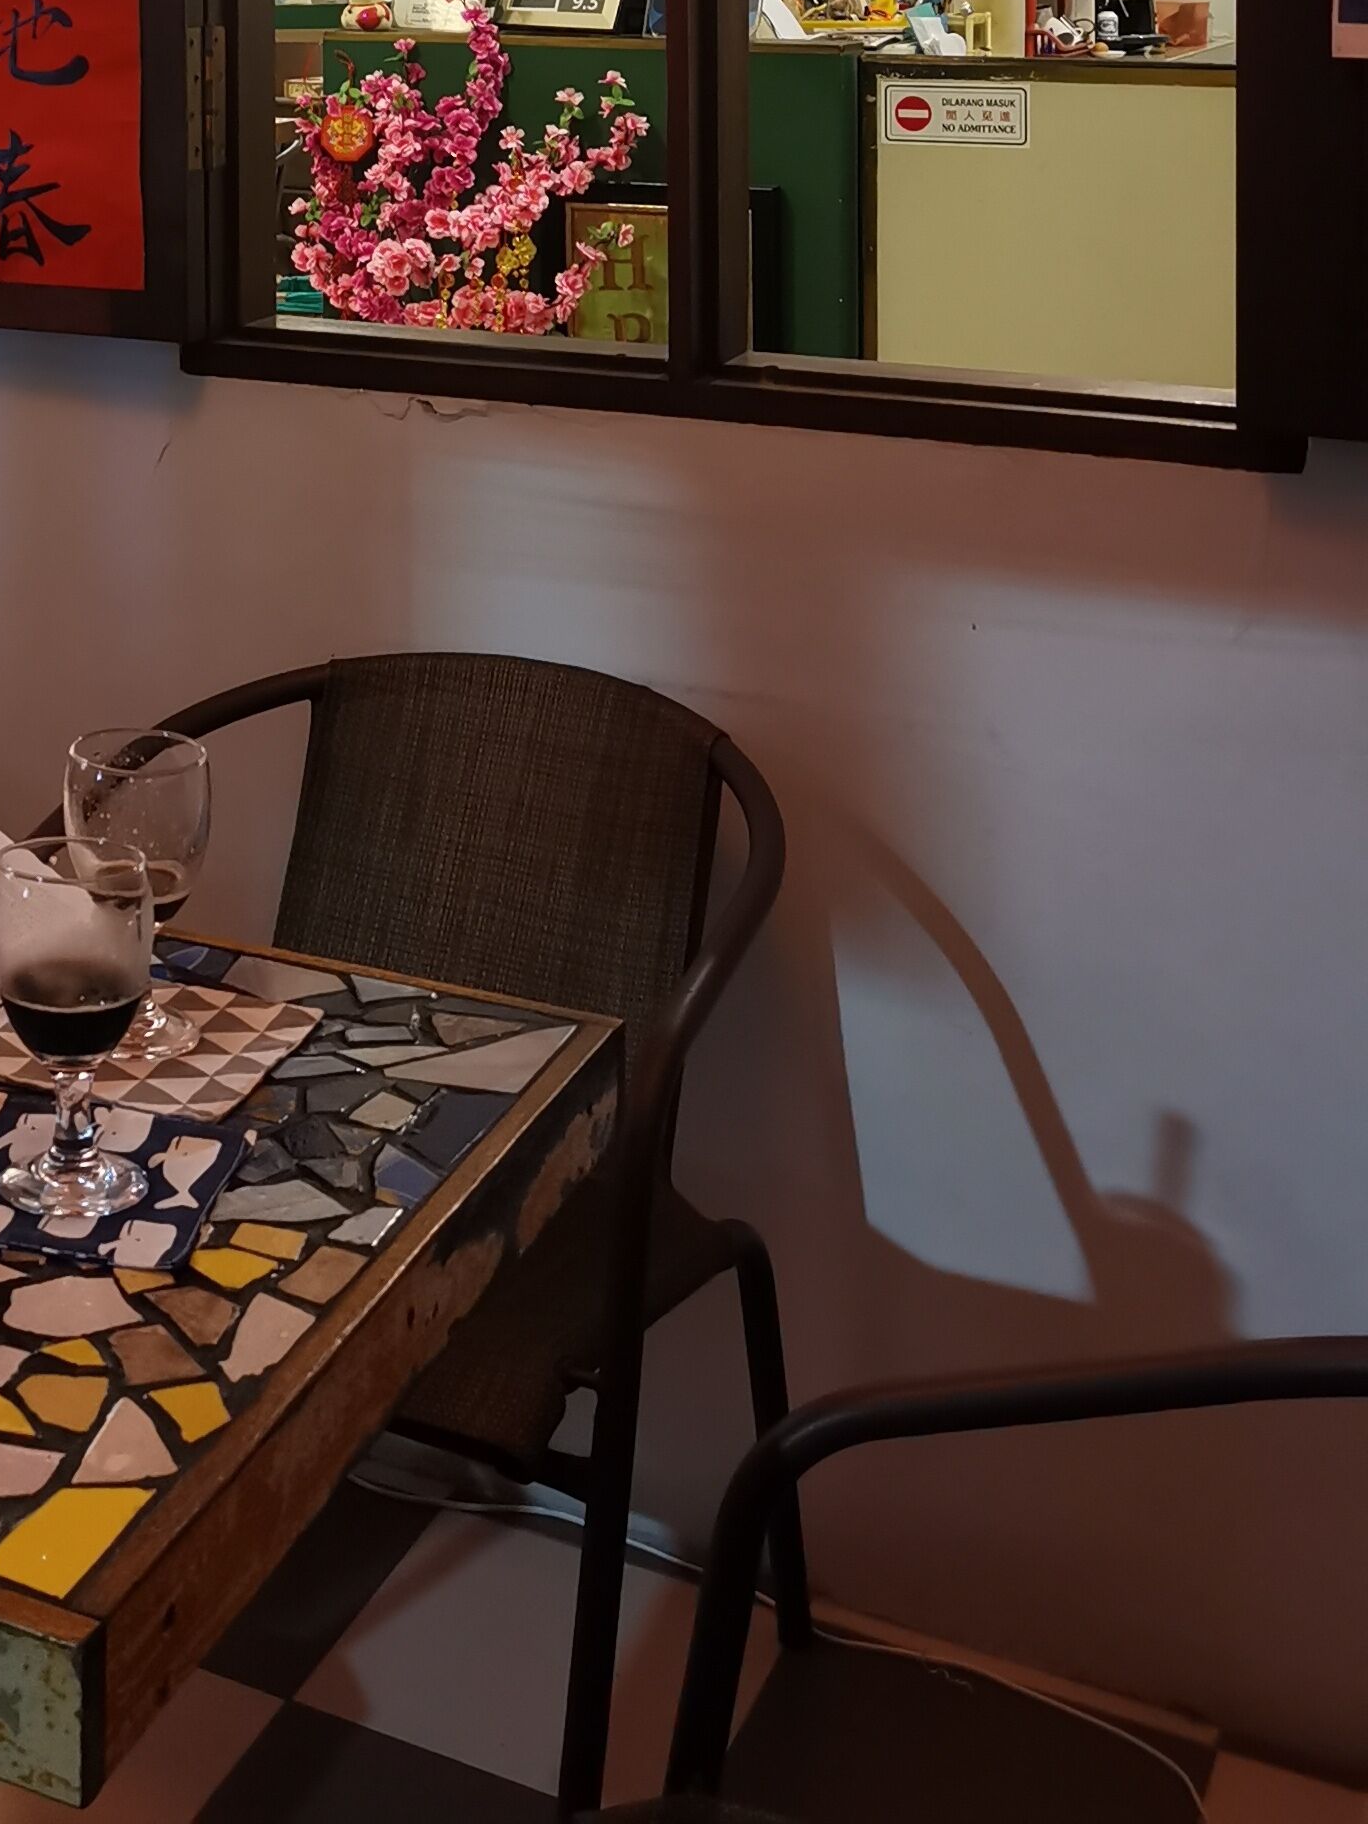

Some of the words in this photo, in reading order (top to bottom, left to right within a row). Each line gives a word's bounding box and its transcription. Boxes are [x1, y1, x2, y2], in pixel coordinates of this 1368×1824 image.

[941, 97, 984, 107] DILARANG
[986, 98, 1016, 108] MASUK
[942, 123, 956, 133] NO
[958, 124, 1016, 134] ADMITTANCE
